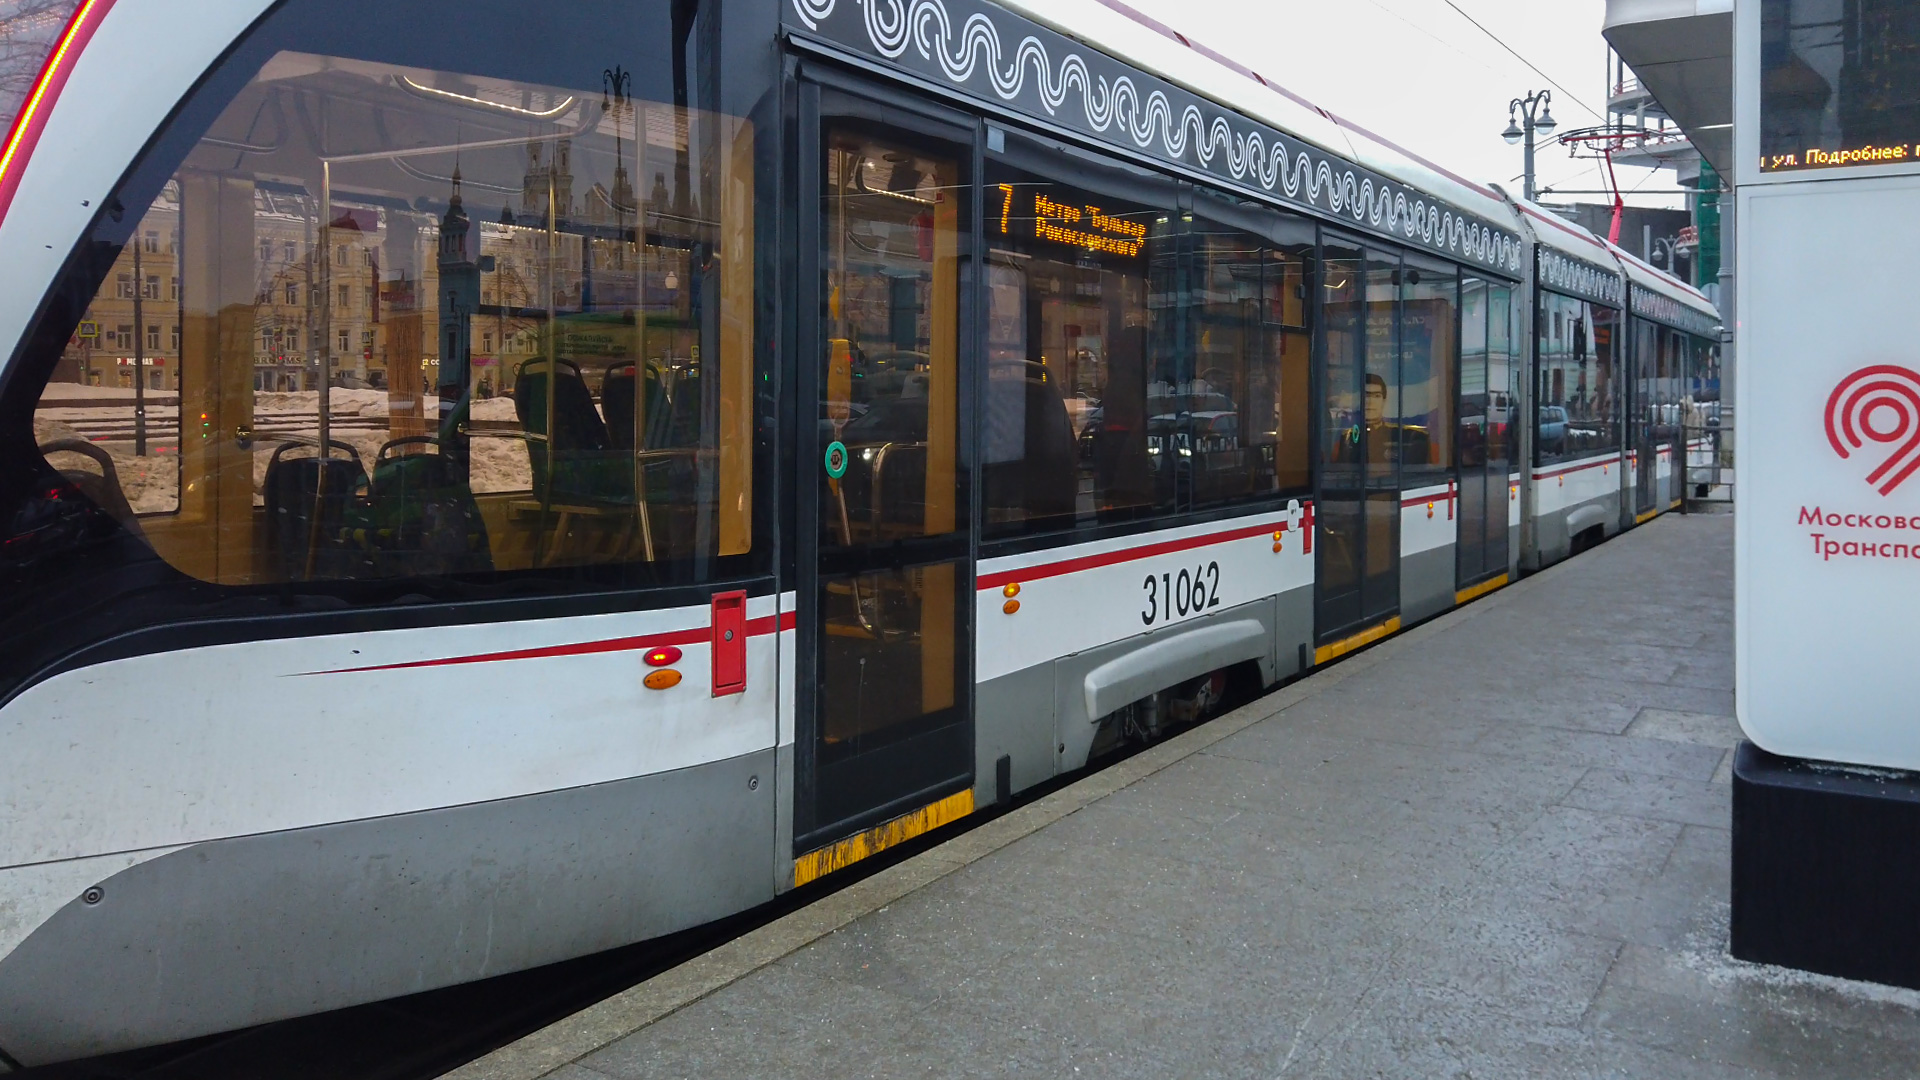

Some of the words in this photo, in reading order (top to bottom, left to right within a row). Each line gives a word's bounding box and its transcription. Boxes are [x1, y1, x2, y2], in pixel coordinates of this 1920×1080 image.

[1772, 154, 1798, 169] ул.
[1806, 143, 1908, 164] Подробнее:
[999, 183, 1013, 233] 7
[1035, 193, 1081, 223] Метро
[1798, 506, 1920, 530] Московс
[1141, 561, 1220, 626] 31062
